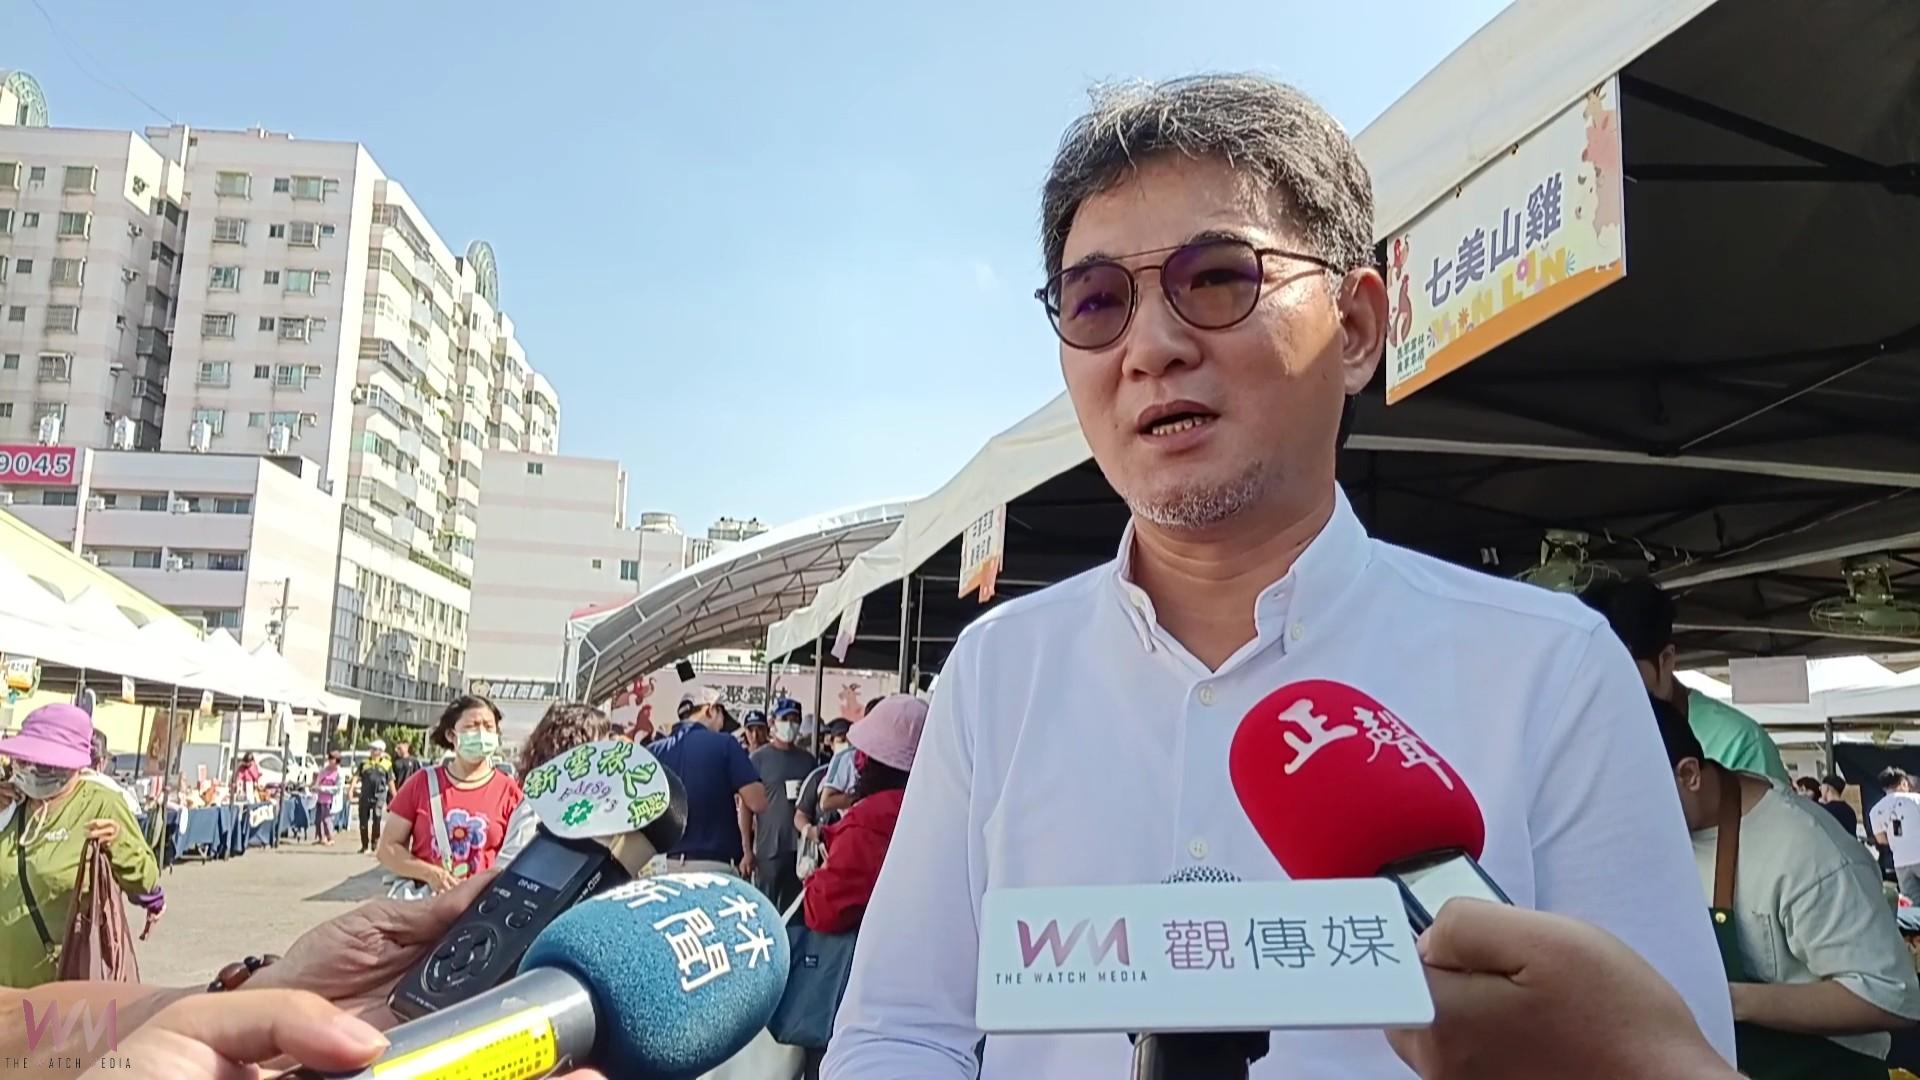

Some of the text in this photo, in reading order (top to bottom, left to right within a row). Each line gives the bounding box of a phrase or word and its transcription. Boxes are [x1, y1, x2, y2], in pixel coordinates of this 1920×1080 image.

[1425, 172, 1562, 308] 七美山雞
[1278, 698, 1455, 791] 正聲
[523, 741, 666, 828] 新雲林之聲
[996, 971, 1148, 985] THE WATCH MEDIA
[1017, 917, 1130, 968] WM
[1162, 914, 1402, 971] 觀傳媒
